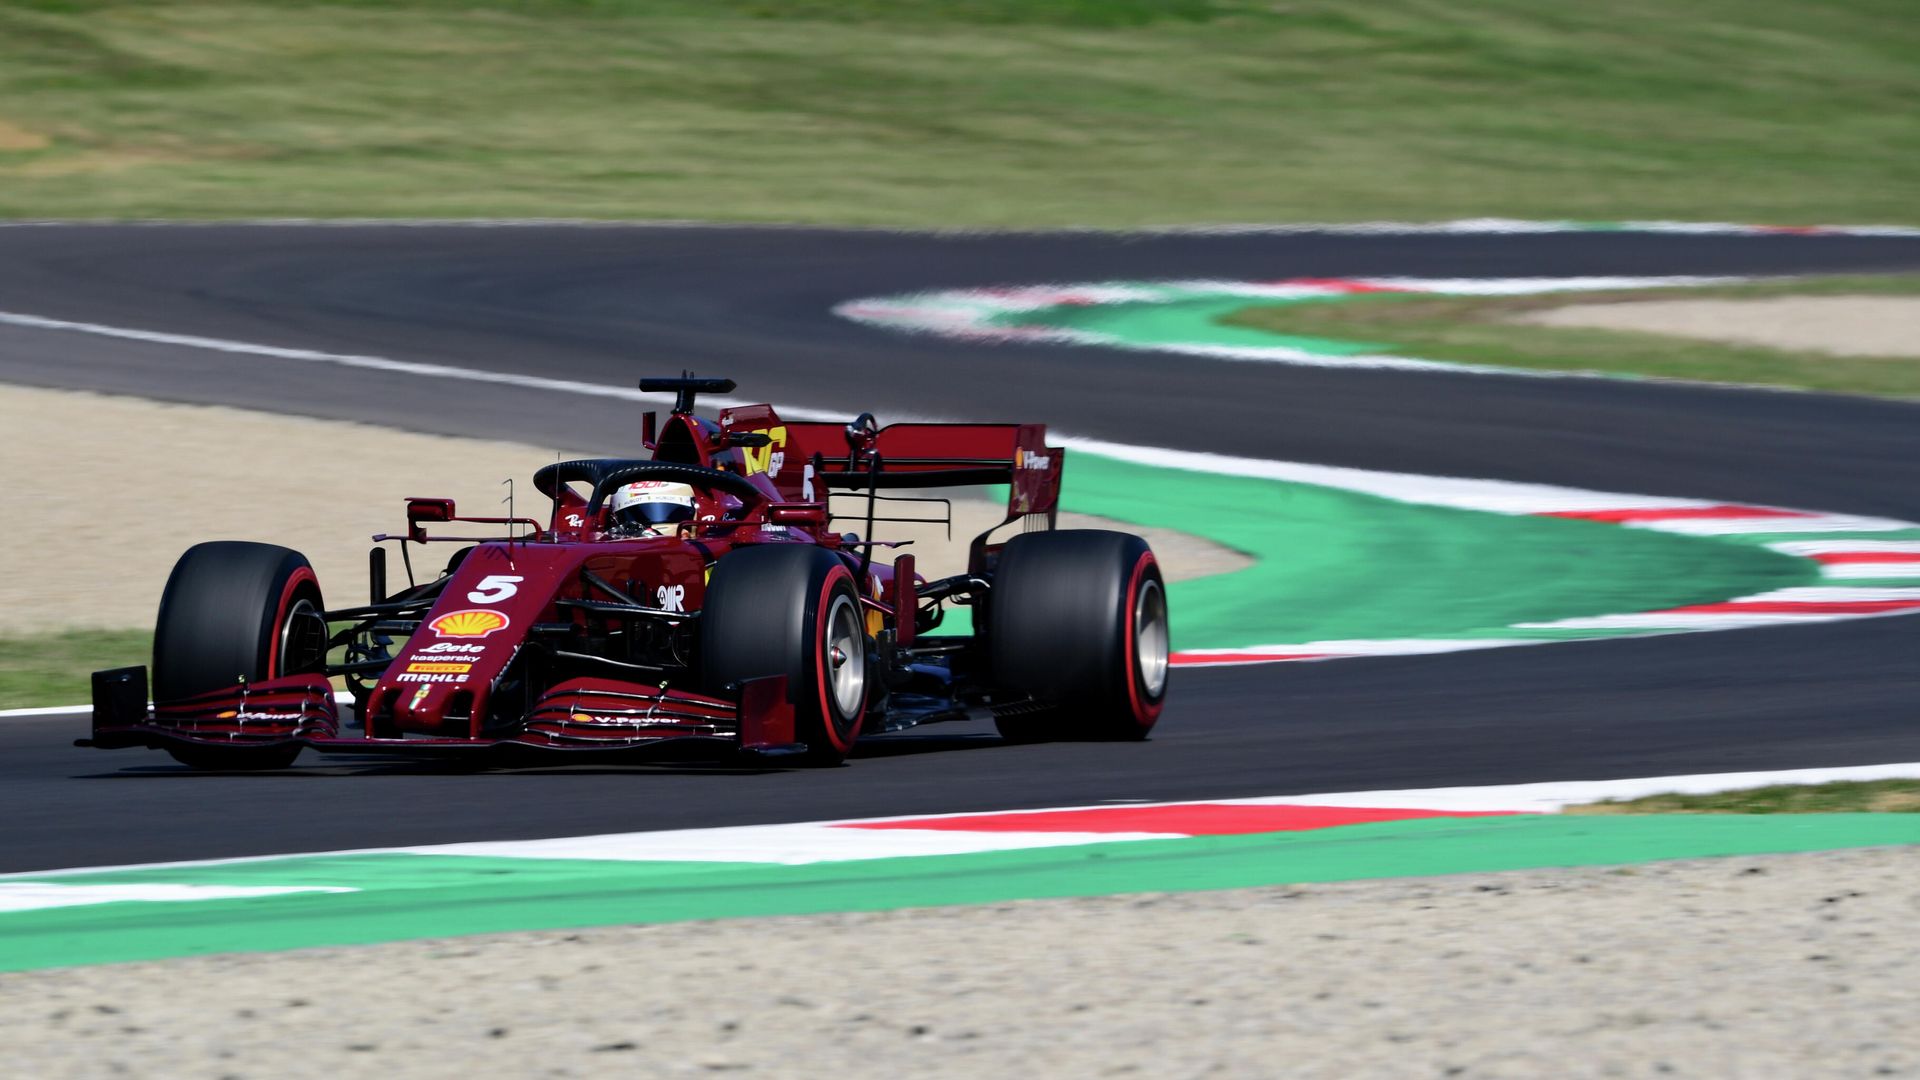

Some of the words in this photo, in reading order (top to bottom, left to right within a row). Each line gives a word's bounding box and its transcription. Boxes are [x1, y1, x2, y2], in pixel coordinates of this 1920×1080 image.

[467, 575, 524, 604] 5
[410, 655, 480, 663] kaspersky
[396, 673, 470, 682] MAHLE
[594, 716, 681, 724] V-Power
